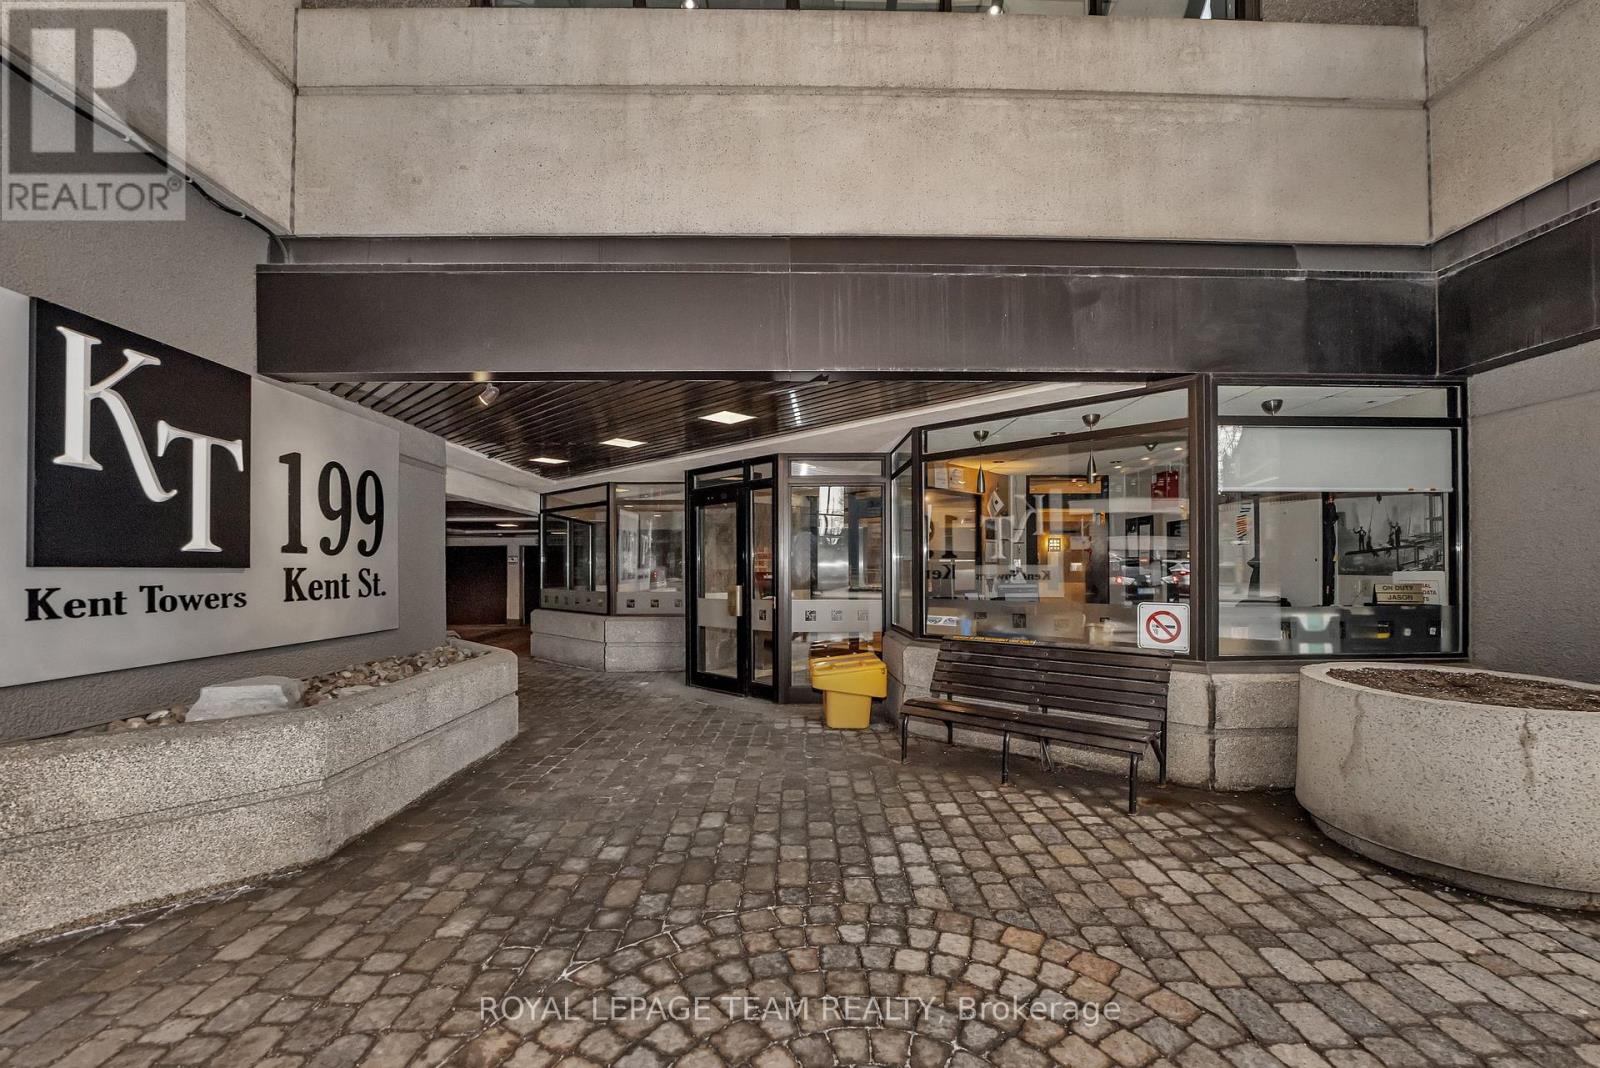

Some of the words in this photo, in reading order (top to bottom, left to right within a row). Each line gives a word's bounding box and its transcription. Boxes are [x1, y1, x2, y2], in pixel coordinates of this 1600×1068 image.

[53, 326, 244, 553] KT
[279, 451, 384, 557] 199
[25, 587, 128, 621] Kent
[139, 584, 247, 614] Towers
[283, 567, 350, 602] Kent
[358, 569, 386, 597] St.
